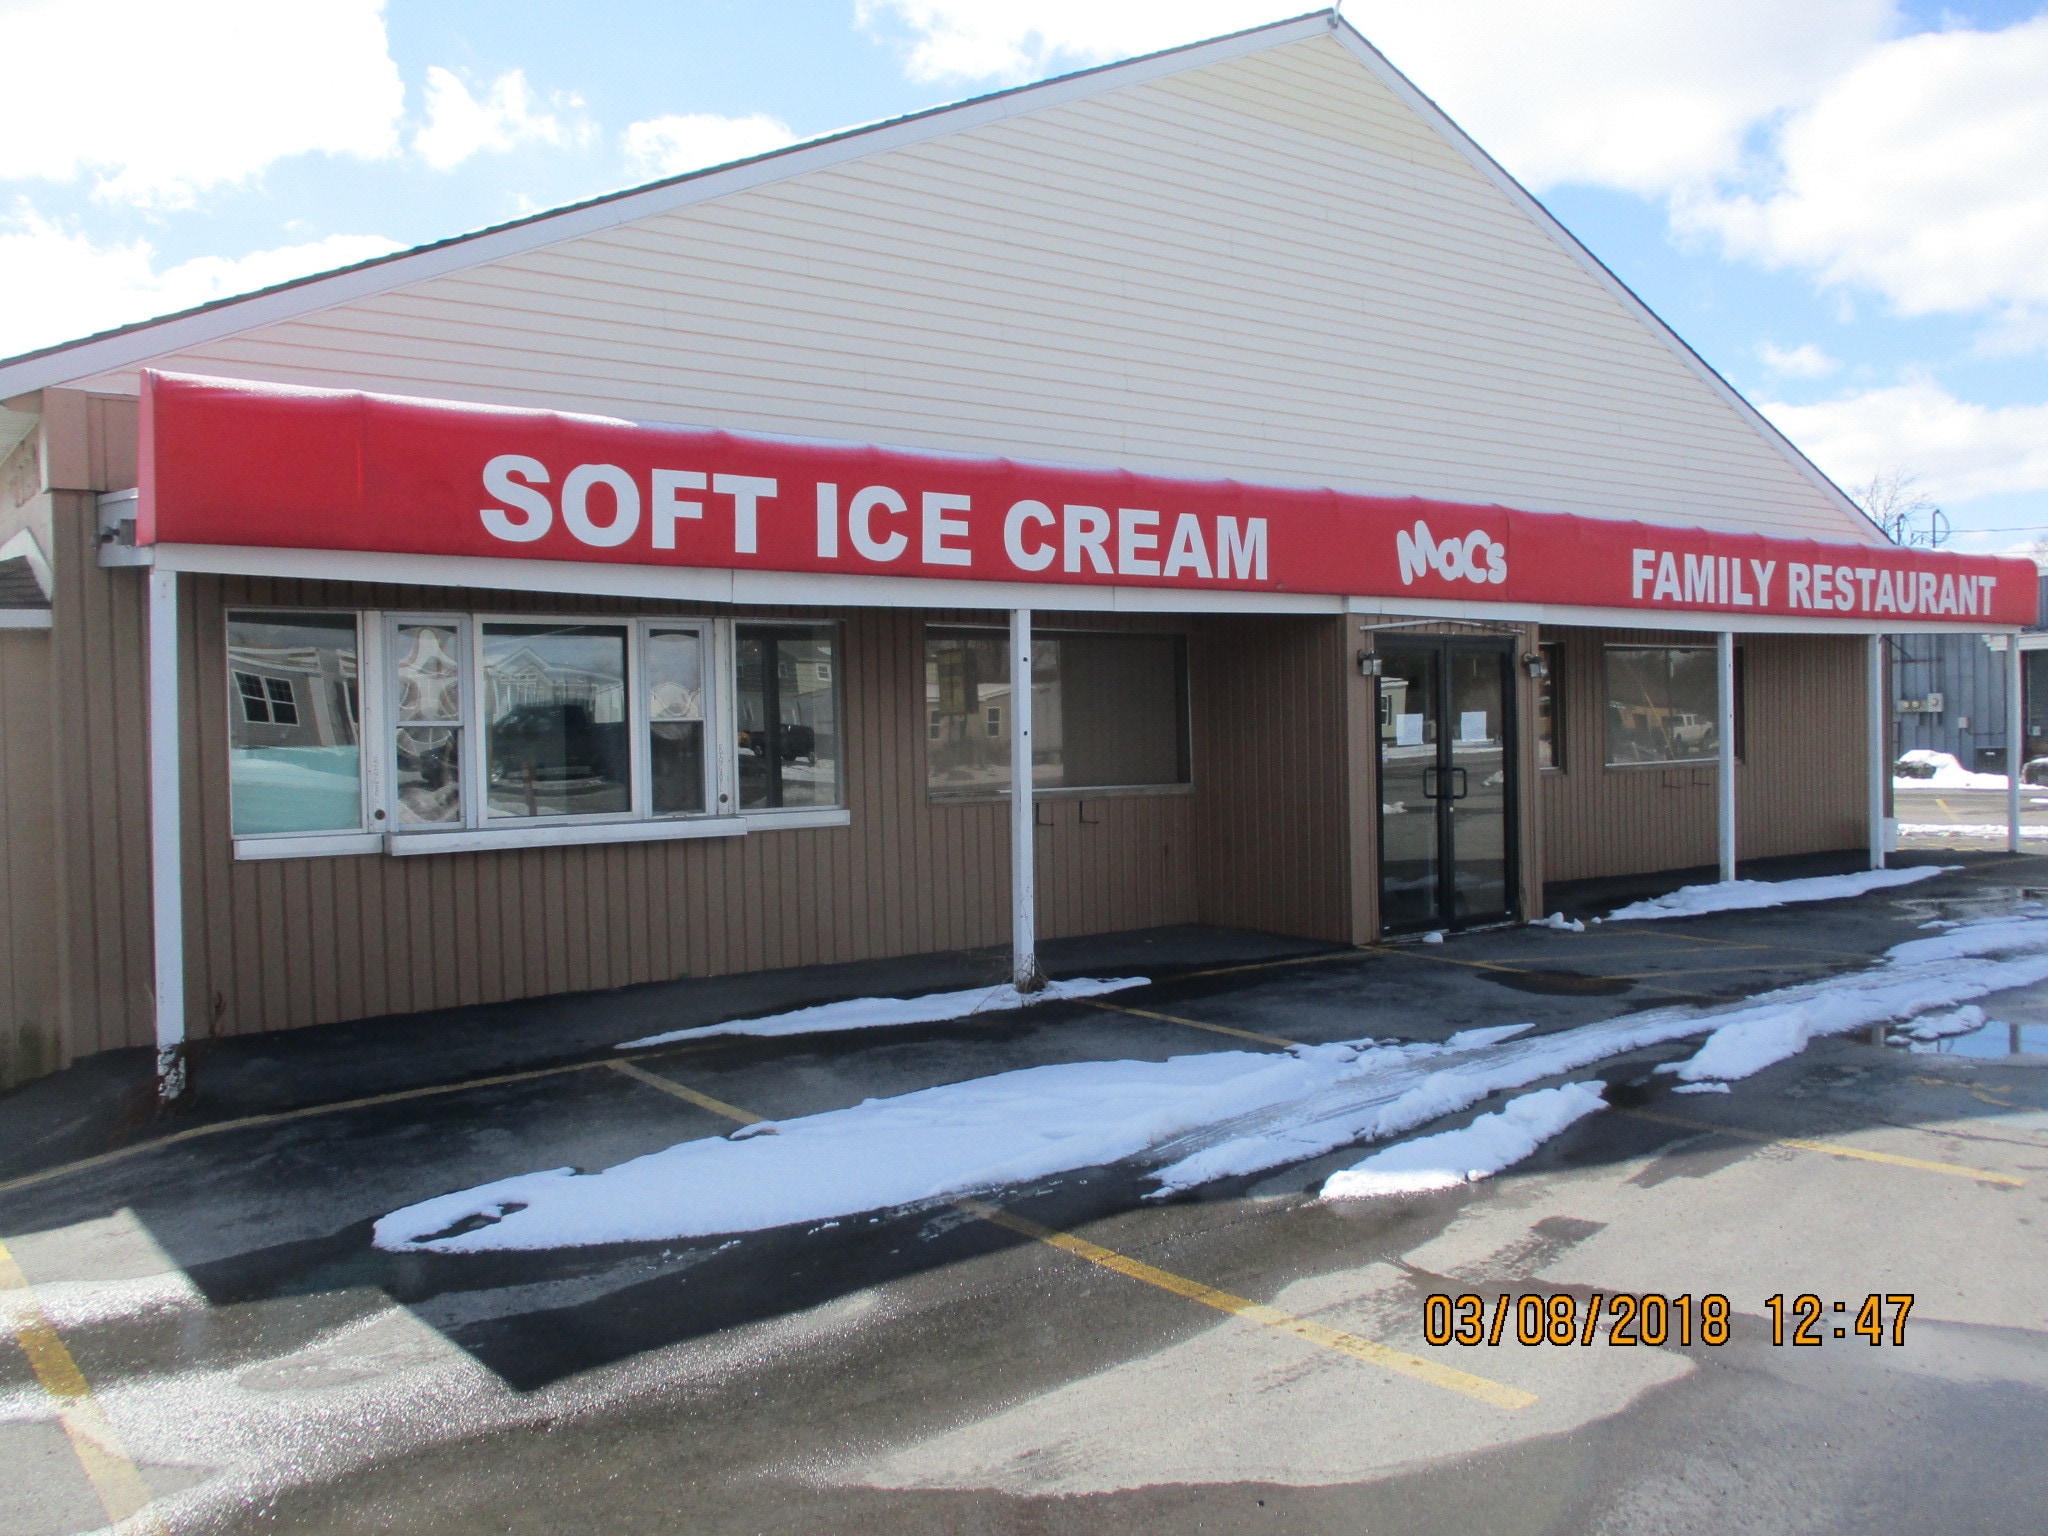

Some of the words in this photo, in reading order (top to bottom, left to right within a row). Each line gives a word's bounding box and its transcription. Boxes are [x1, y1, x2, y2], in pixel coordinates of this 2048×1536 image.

[480, 455, 777, 553] SOFT
[817, 483, 971, 567] ICE
[1004, 500, 1268, 581] CREAM
[1633, 549, 1776, 607] FAMILY
[1788, 563, 1997, 616] RESTAURANT
